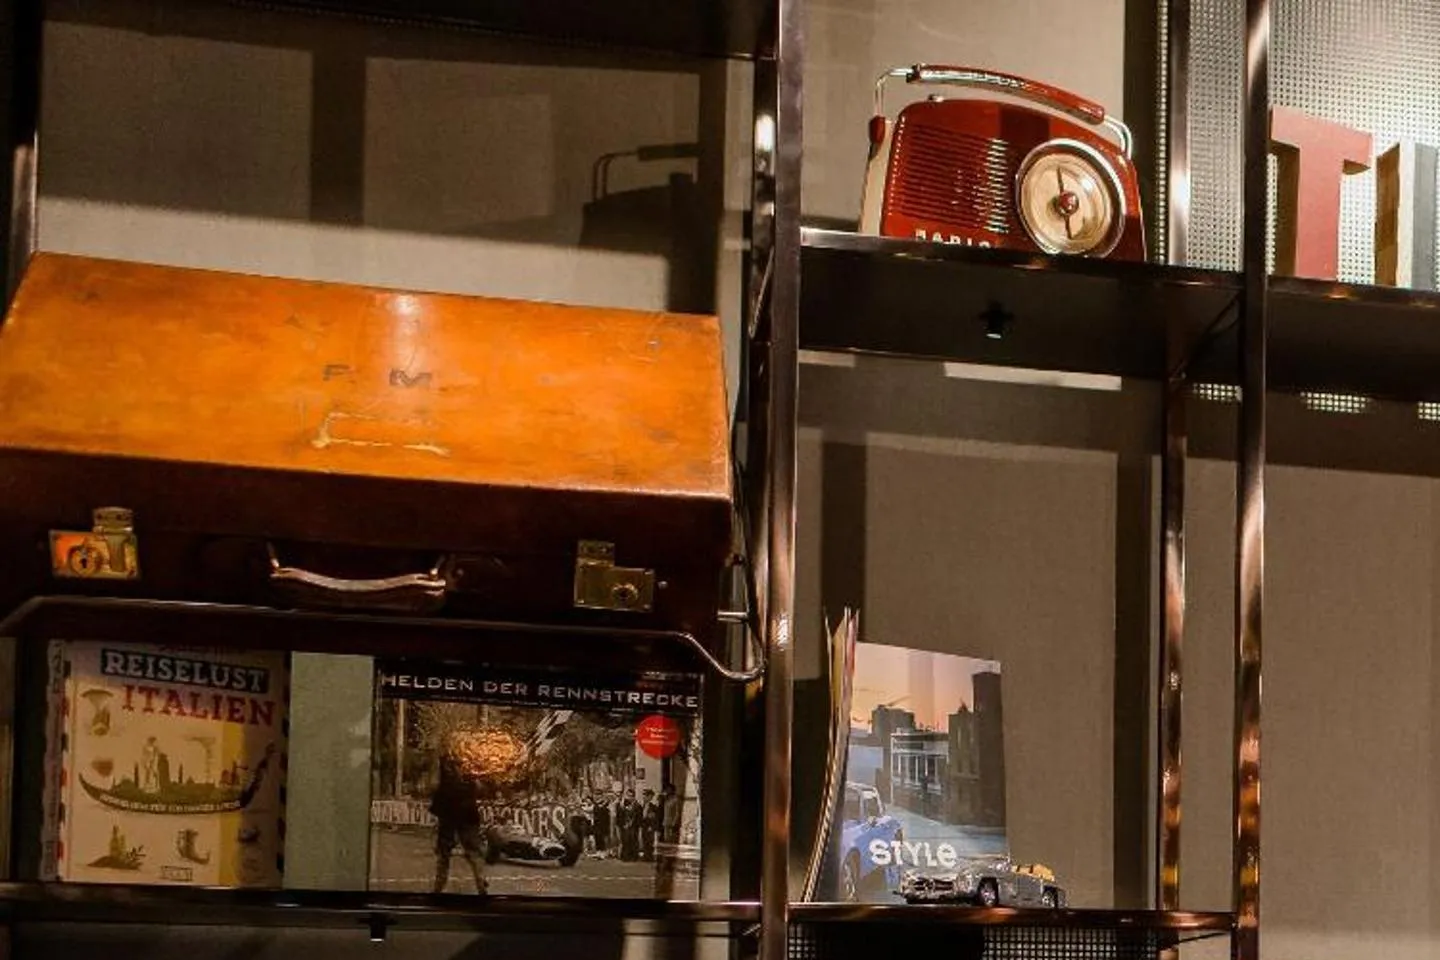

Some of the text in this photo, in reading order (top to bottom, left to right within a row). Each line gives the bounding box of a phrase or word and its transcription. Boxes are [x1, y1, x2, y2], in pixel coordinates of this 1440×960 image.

[105, 652, 265, 691] REISELUST
[381, 674, 473, 692] HELDEN
[484, 681, 529, 696] DER
[538, 685, 698, 708] RENNSTRECKE
[122, 684, 276, 726] ITALIEN
